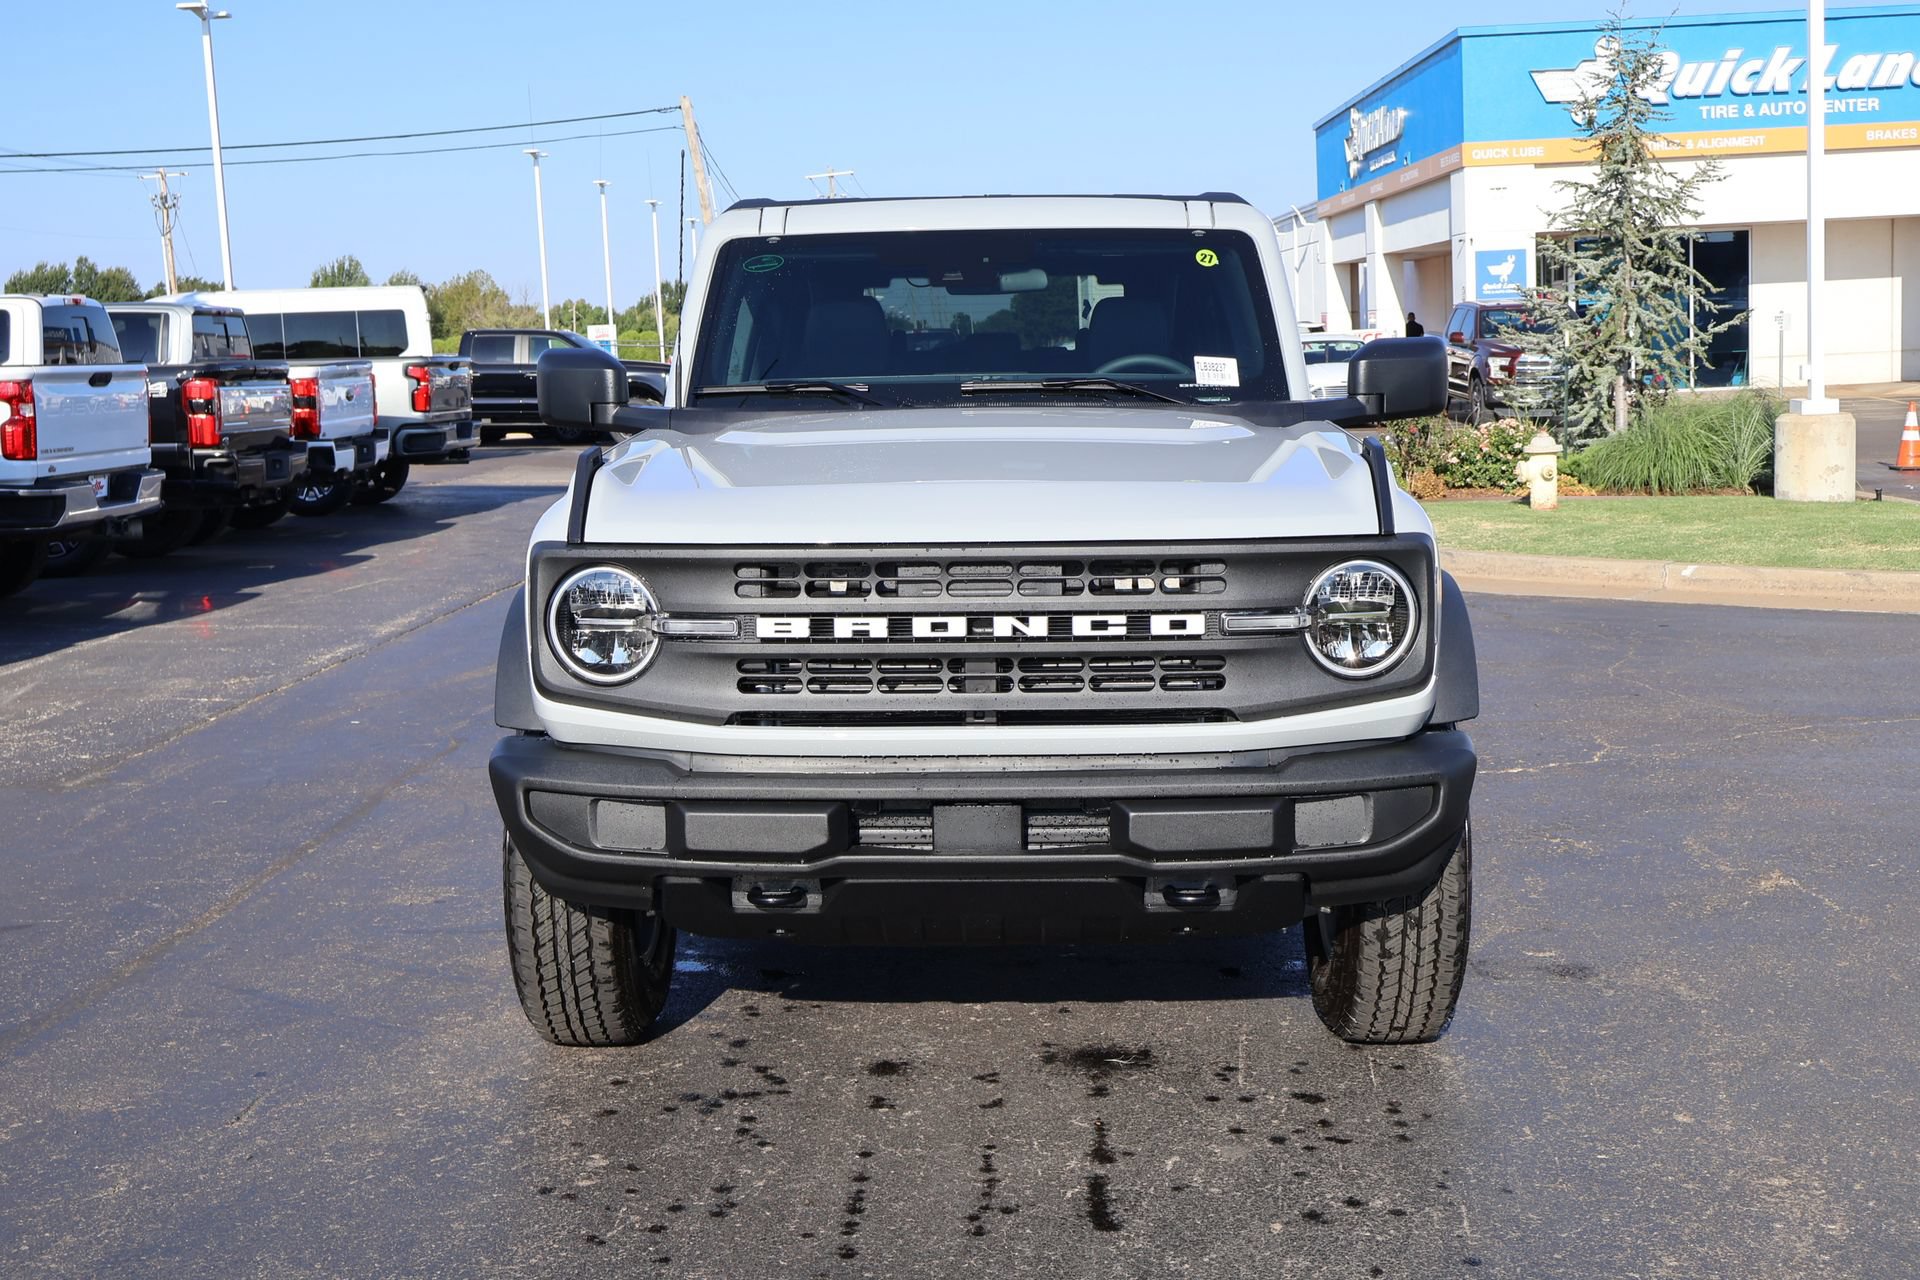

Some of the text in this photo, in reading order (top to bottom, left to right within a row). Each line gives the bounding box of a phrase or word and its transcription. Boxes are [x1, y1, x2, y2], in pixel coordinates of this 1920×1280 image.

[1700, 97, 1880, 120] TIRE & AUTO ENTER
[1866, 128, 1918, 141] BRAKES
[1685, 139, 1695, 150] &
[1696, 135, 1766, 149] ALIGNMENT
[1471, 147, 1509, 160] QUICK
[1512, 146, 1544, 158] LUBE
[1200, 253, 1213, 263] 27
[756, 615, 1206, 639] BRONCO
